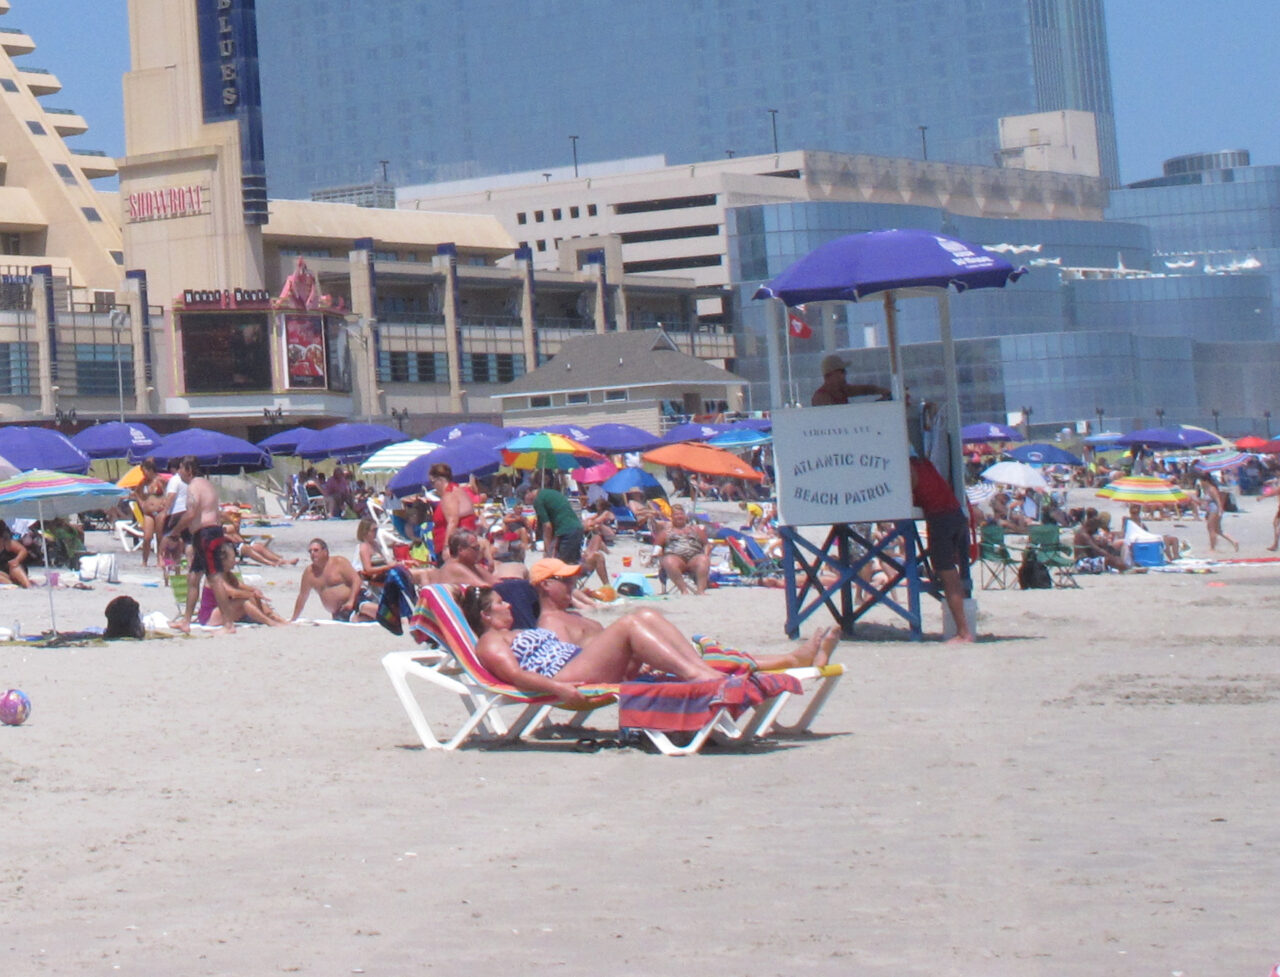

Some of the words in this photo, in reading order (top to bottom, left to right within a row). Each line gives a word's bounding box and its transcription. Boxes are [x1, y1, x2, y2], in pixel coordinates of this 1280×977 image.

[129, 185, 203, 217] SHOWBOAT
[793, 453, 854, 476] ATLANTIC
[860, 454, 890, 471] CITY
[794, 486, 839, 505] BEACH
[845, 482, 892, 504] PATROL
